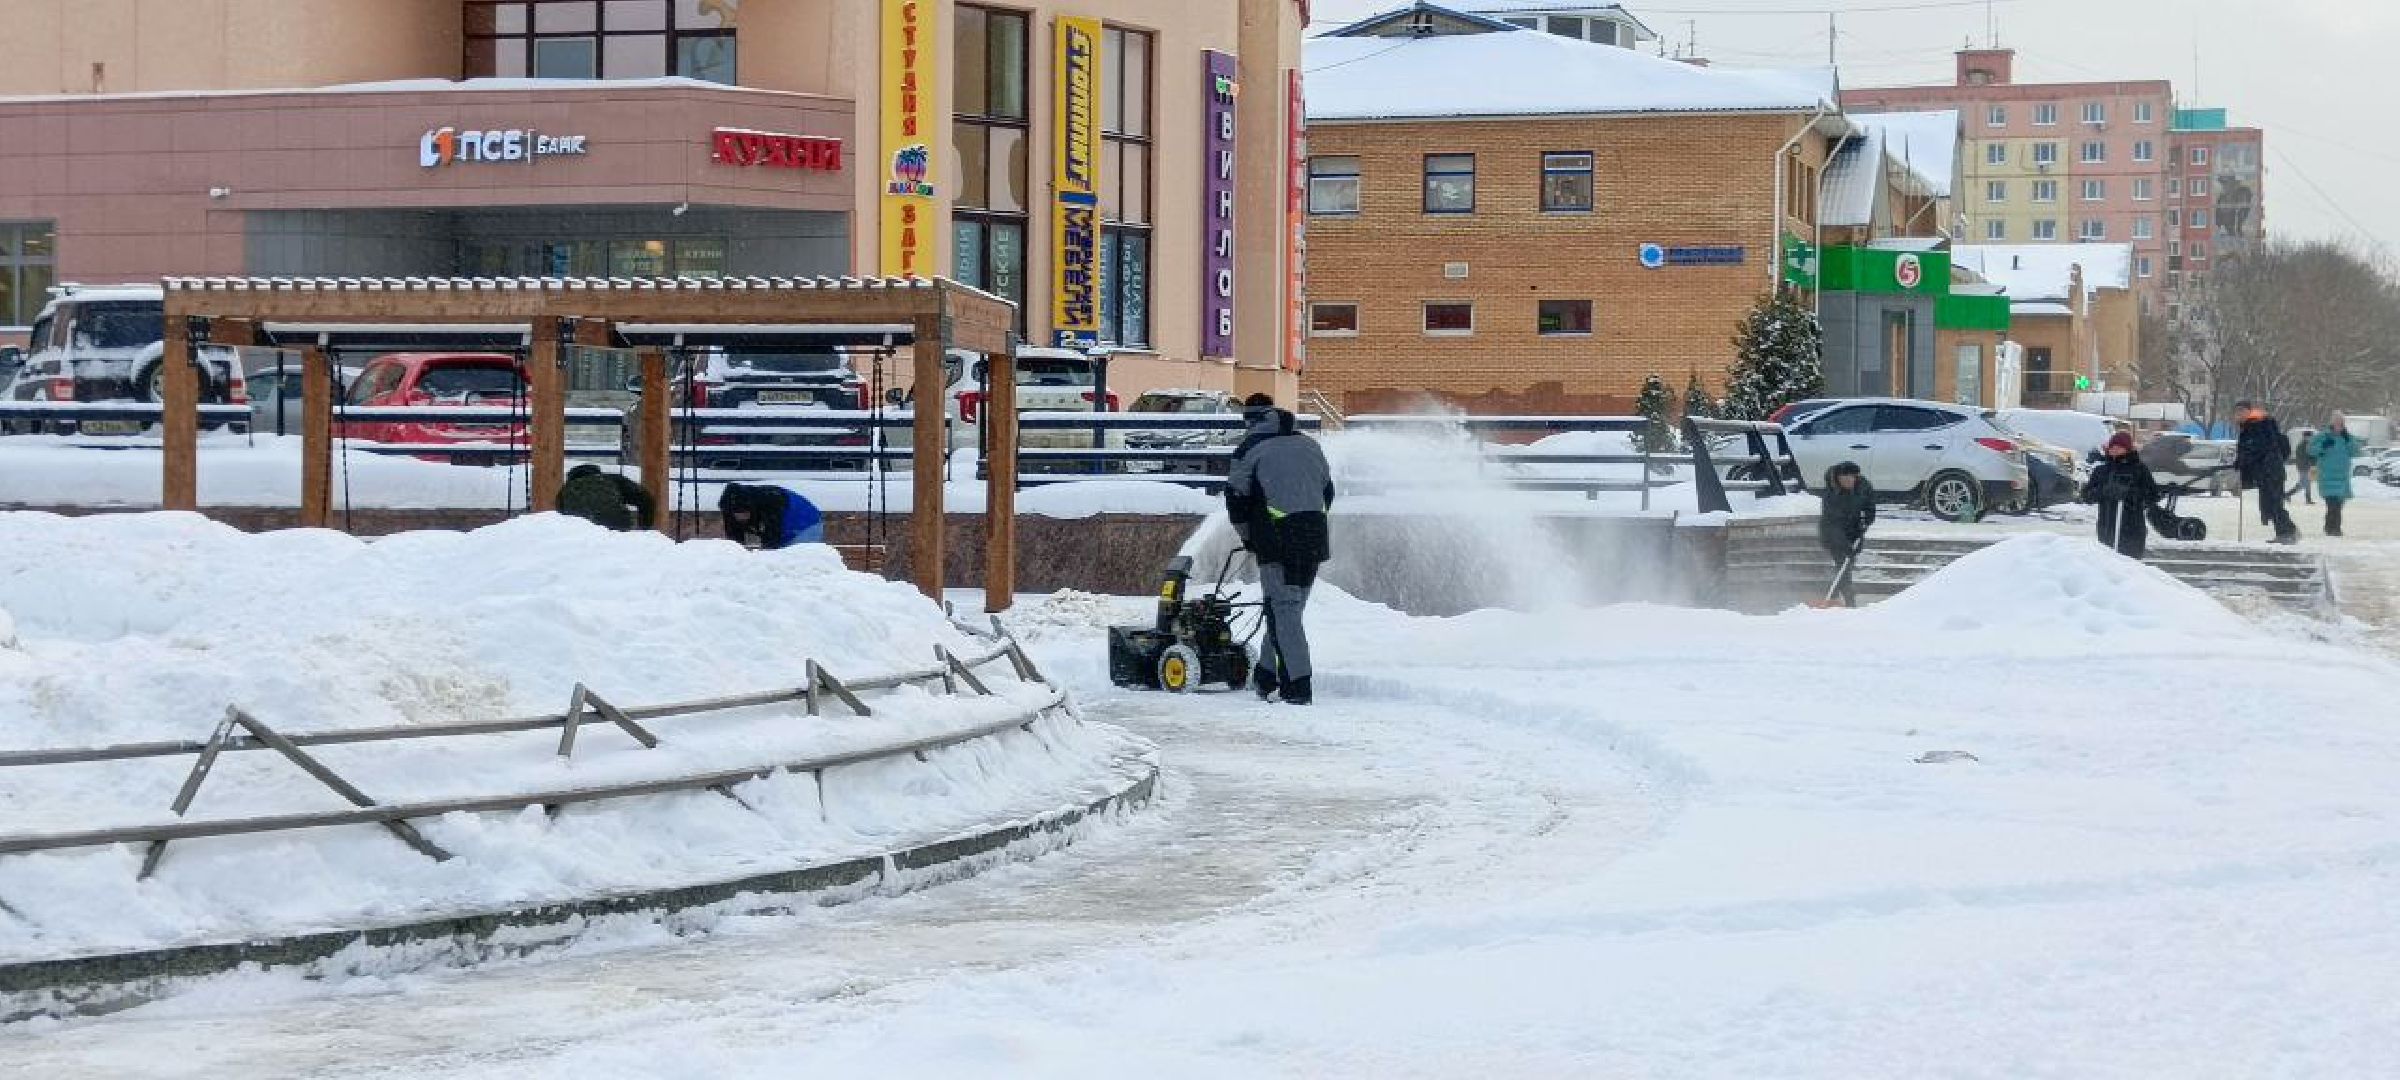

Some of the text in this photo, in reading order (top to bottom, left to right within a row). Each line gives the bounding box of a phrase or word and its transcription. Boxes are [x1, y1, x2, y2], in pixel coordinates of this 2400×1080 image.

[901, 2, 917, 137] СТУДИЯ
[460, 130, 587, 160] ПСБ БАНК
[712, 128, 842, 171] КУХНИ
[1064, 207, 1081, 325] МЕБЕЛИ
